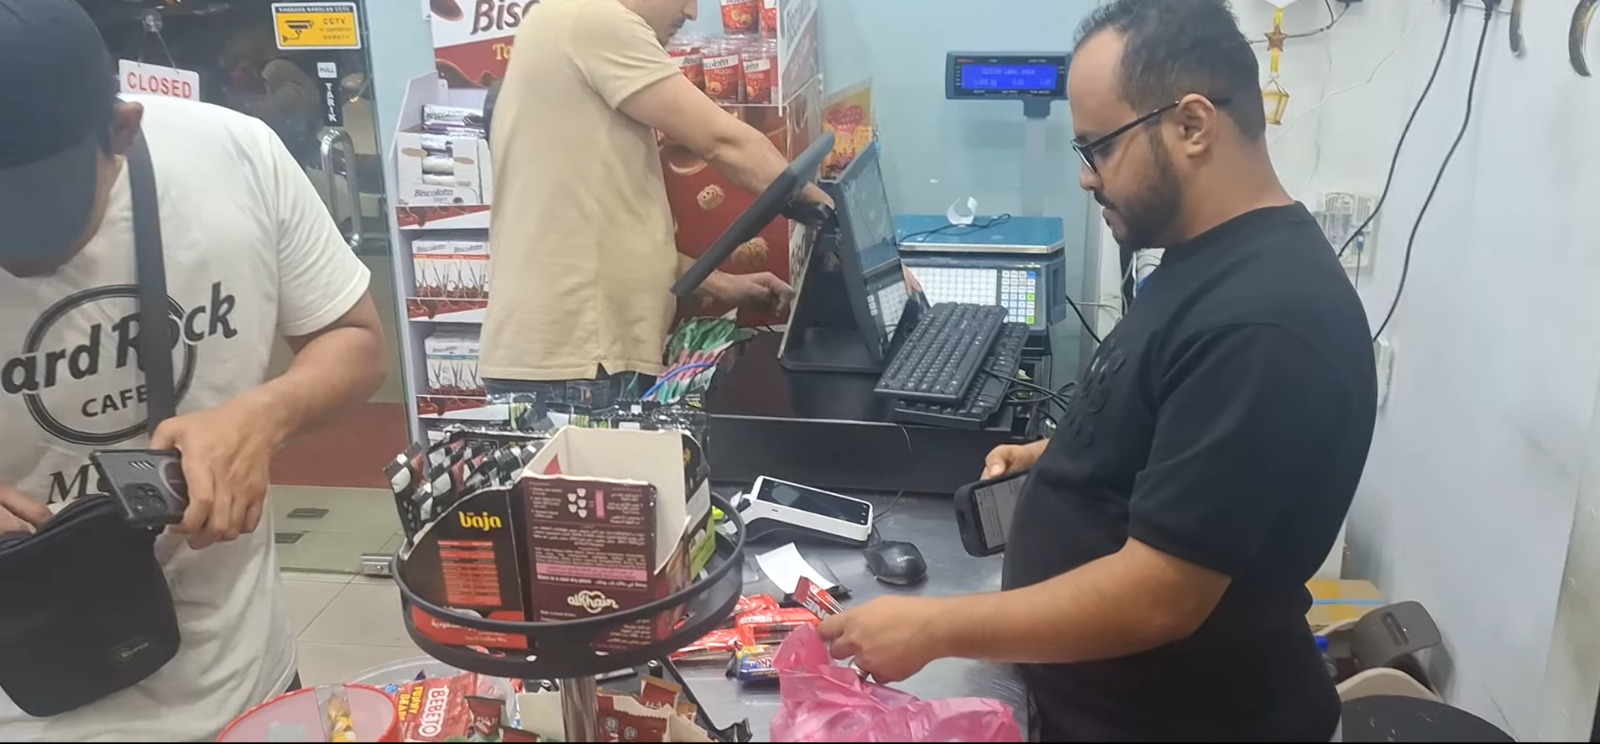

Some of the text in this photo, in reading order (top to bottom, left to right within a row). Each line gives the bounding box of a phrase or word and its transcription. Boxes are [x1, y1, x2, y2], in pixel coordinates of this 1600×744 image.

[127, 72, 192, 99] CLOSED
[325, 82, 337, 122] TARIK
[458, 510, 503, 532] baja
[419, 687, 449, 736] BEBETO
